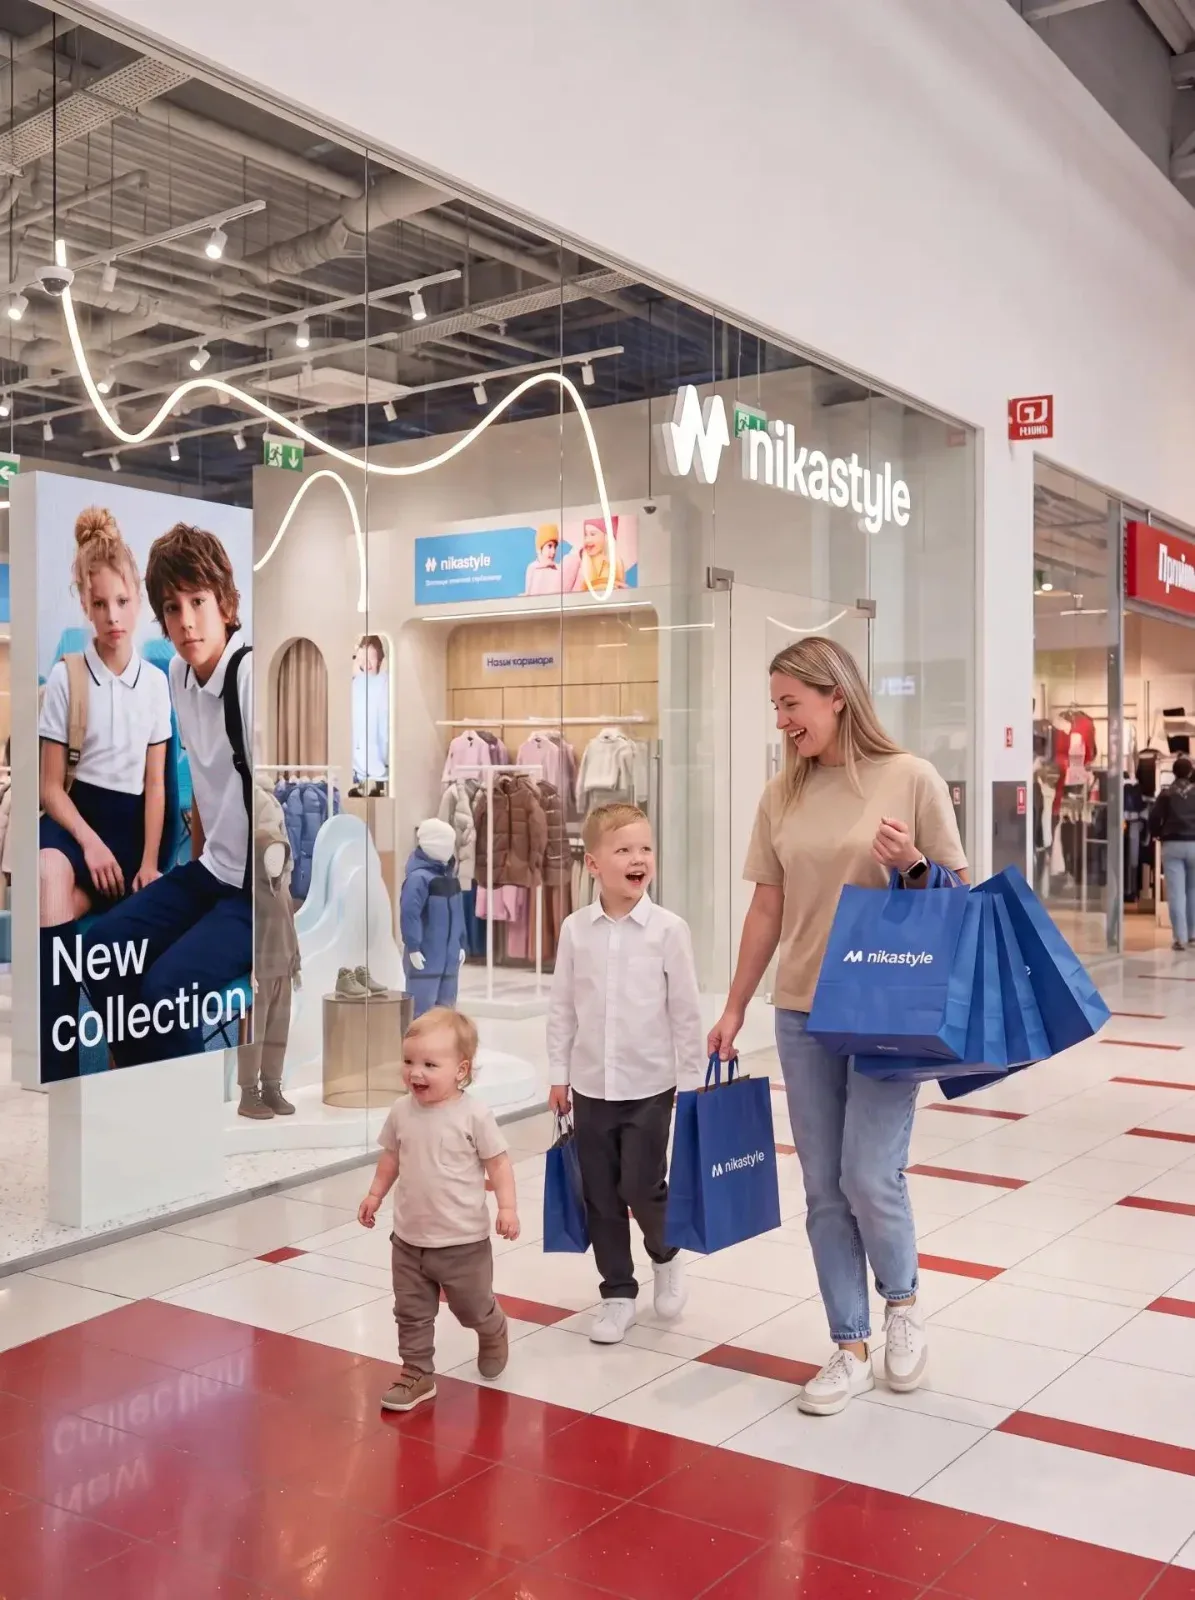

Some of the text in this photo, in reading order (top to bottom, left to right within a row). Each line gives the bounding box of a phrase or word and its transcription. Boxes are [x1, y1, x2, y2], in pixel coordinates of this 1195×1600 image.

[748, 420, 911, 534] nikastyle
[440, 553, 491, 572] nikastyle
[52, 933, 149, 986] New
[867, 950, 933, 967] nikastyle
[51, 982, 246, 1052] collection
[725, 1150, 765, 1172] nikastyle
